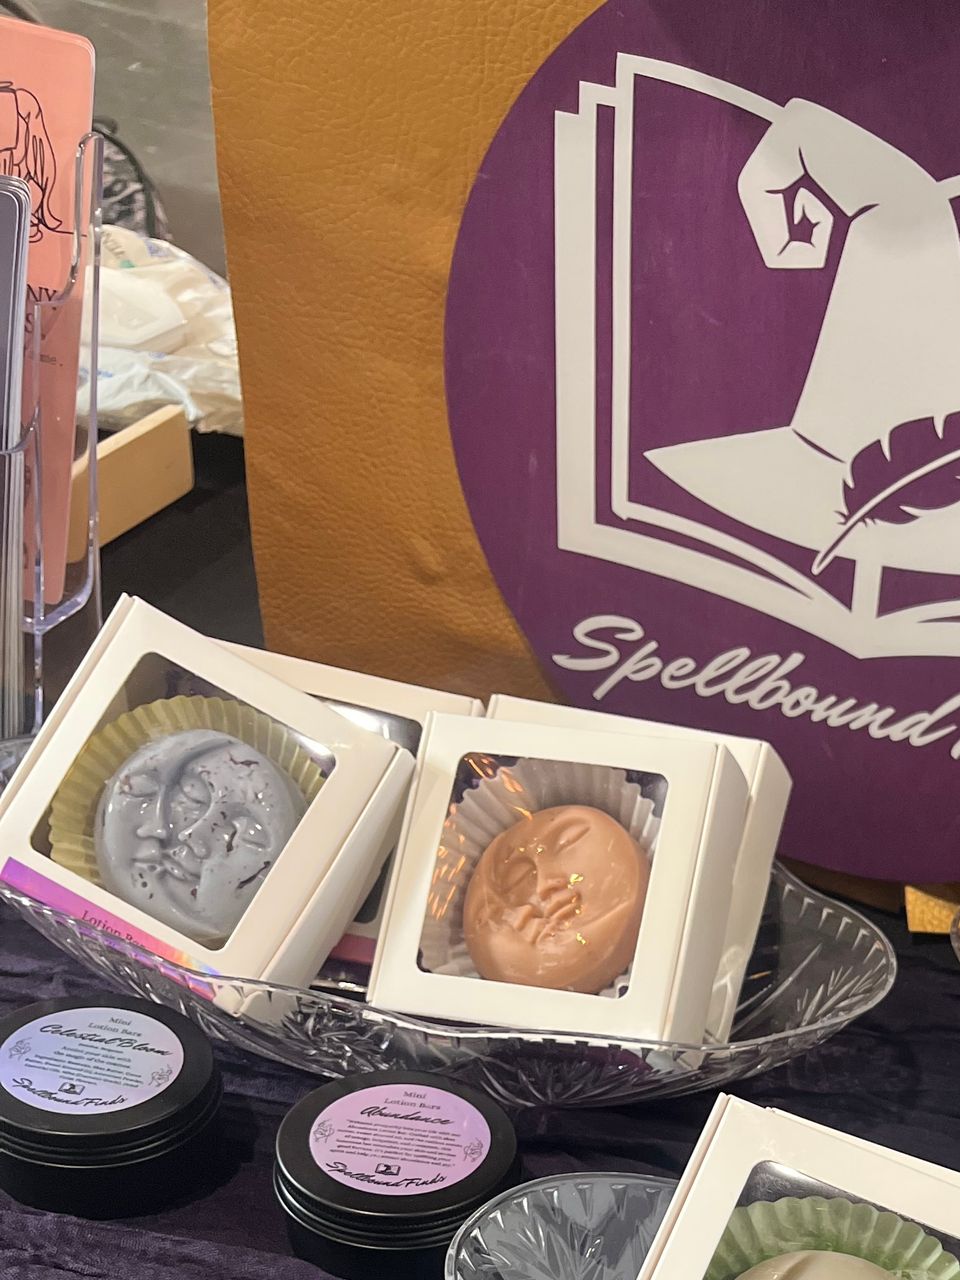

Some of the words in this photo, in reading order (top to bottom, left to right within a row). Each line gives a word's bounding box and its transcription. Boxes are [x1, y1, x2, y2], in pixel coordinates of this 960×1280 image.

[81, 909, 121, 938] Lotion
[88, 1022, 120, 1034] Lotion
[121, 1028, 143, 1038] Bars
[109, 1016, 133, 1026] Mini
[39, 1024, 125, 1045] Celestial
[119, 1038, 174, 1057] Bloom
[12, 1077, 85, 1106] Spellbound
[83, 1094, 130, 1107] Finds
[402, 1091, 428, 1099] Mini
[384, 1097, 417, 1108] Lotion
[360, 1105, 455, 1125] Abundance
[326, 1162, 406, 1188] Spellbound
[404, 1173, 448, 1187] Finds
